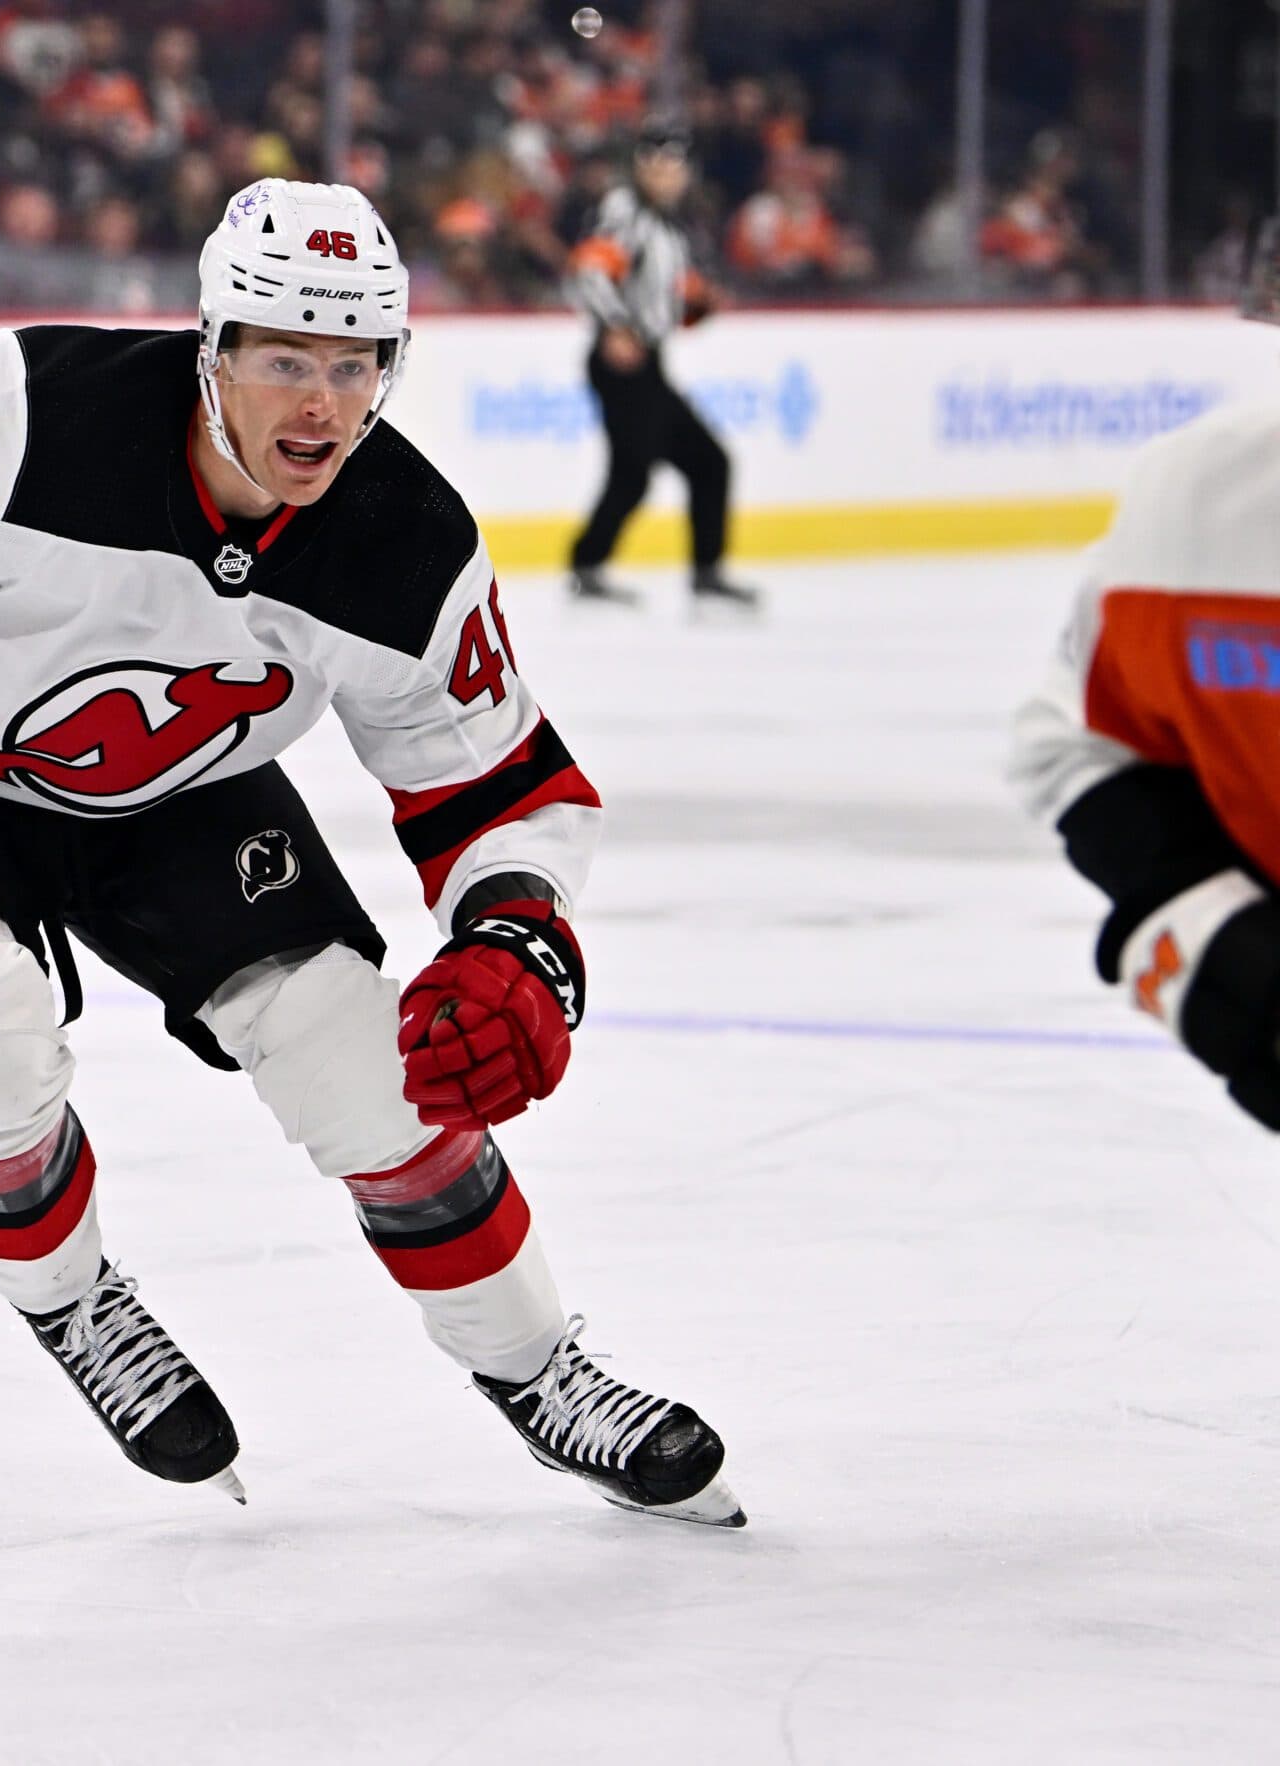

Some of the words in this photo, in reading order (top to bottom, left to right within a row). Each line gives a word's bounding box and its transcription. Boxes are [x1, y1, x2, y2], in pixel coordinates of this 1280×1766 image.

[305, 229, 359, 261] 46
[220, 560, 245, 571] NHL
[472, 918, 578, 1025] CCM
